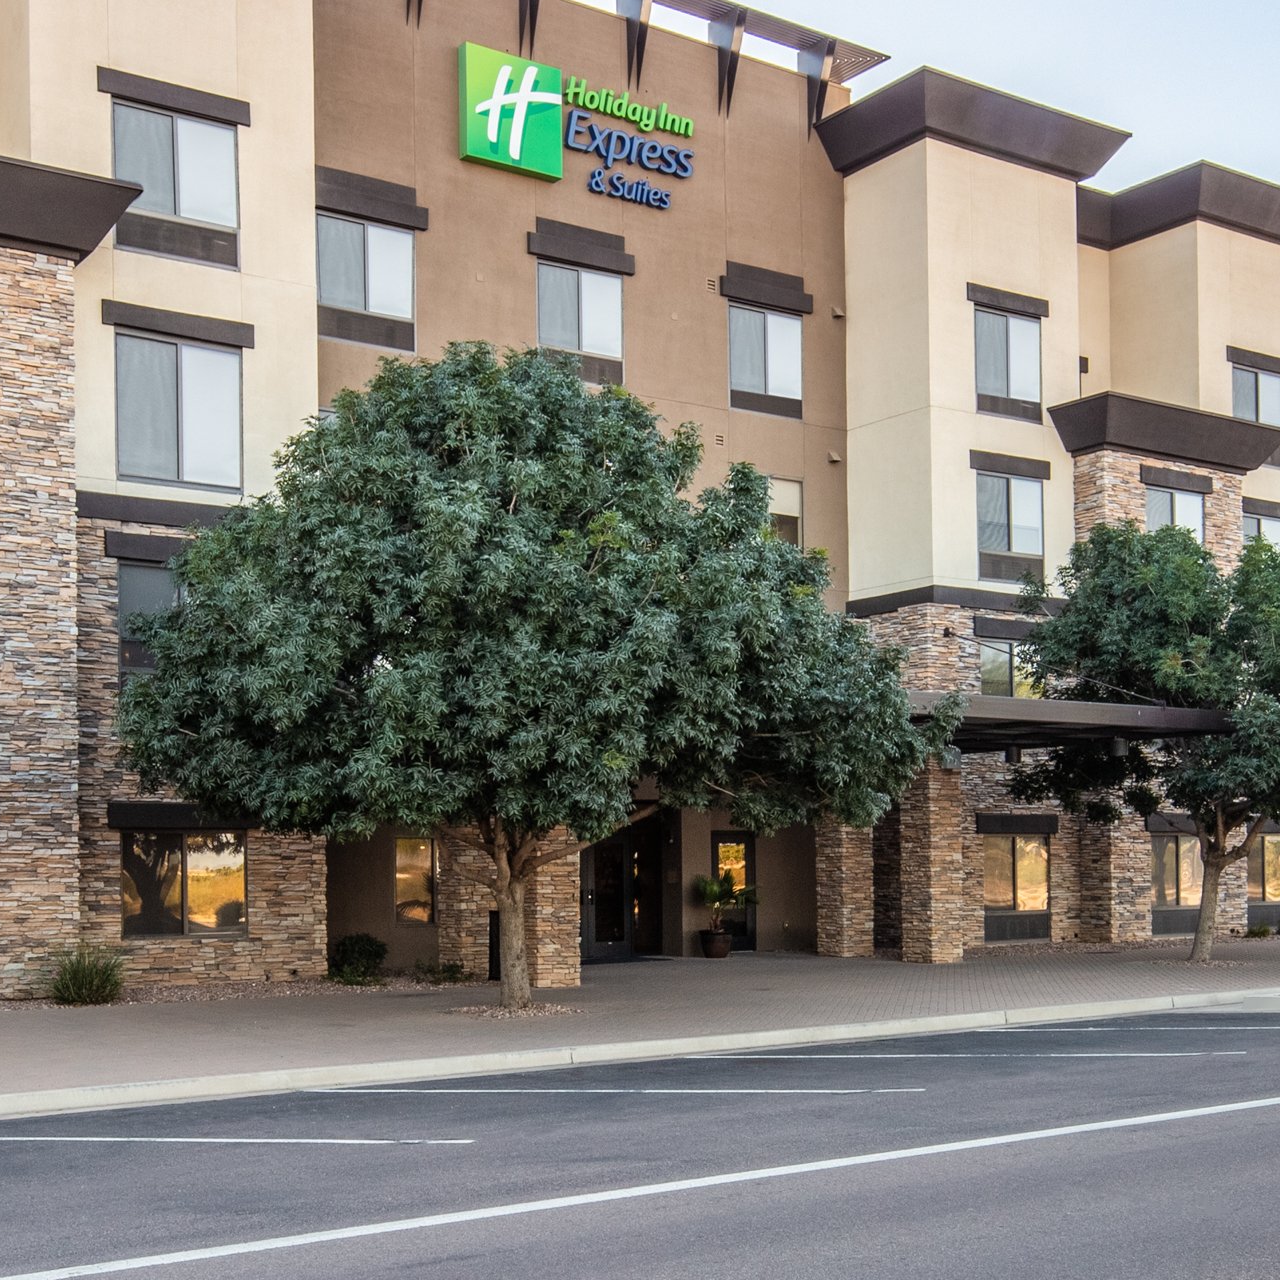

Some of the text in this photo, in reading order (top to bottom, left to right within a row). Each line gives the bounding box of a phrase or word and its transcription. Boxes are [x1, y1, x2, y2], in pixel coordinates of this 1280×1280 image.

[565, 76, 694, 137] Holiday Inn
[565, 109, 694, 178] Express
[588, 168, 671, 210] & Suites
